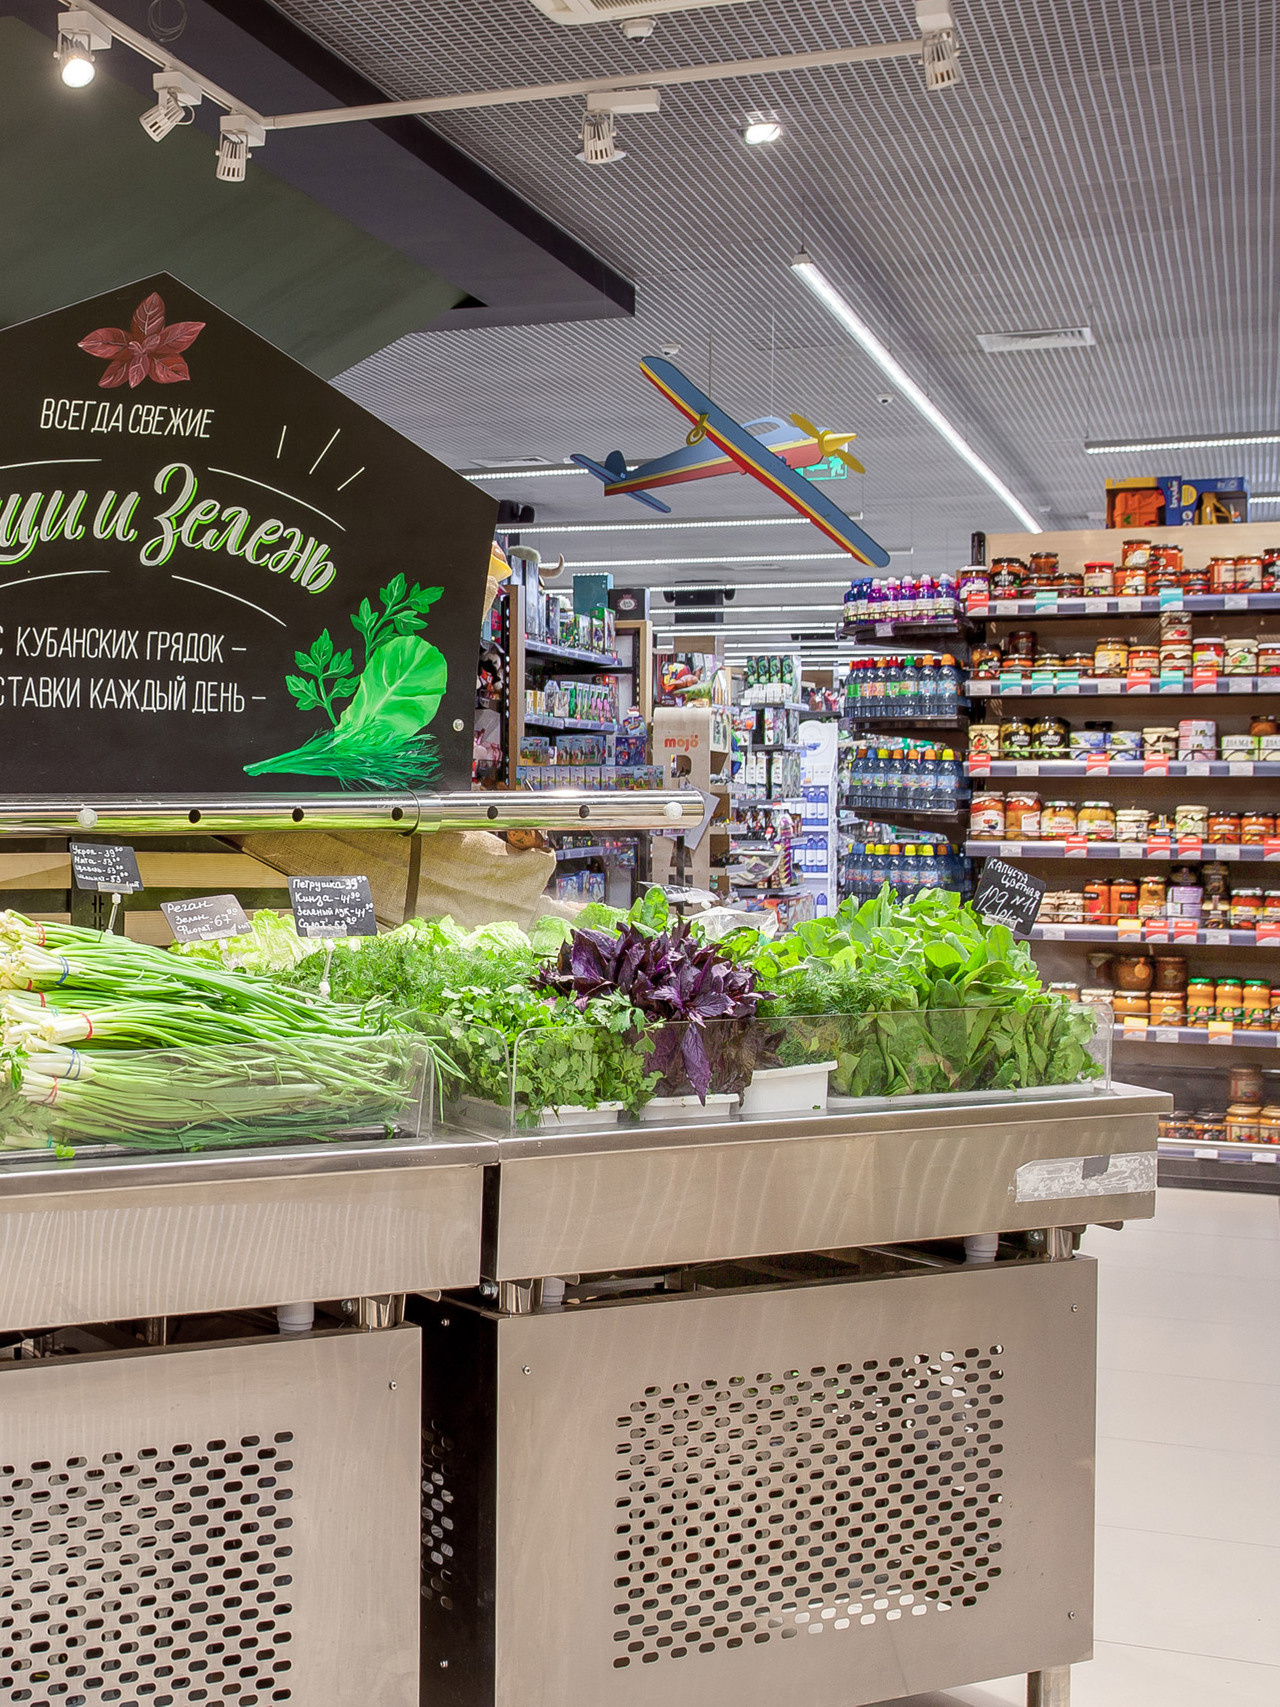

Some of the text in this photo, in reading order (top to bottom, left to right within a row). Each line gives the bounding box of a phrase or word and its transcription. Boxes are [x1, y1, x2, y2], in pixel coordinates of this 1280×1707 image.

[40, 398, 216, 438] ВСЕГДА СВЕЖИЕ
[93, 490, 139, 543] и
[140, 462, 337, 594] Зелень
[16, 626, 139, 660] КУБАНСКИХ
[146, 630, 226, 663] ГРЯДОК
[90, 675, 187, 713] КАЖДЫЙ
[192, 679, 246, 714] ДЕНЬ
[987, 858, 1029, 884] КАПУСТА
[292, 879, 345, 892] Петрушка
[1001, 874, 1041, 900] ЦВЕТНАЯ
[167, 900, 214, 914] Реган
[295, 892, 334, 907] Кинза
